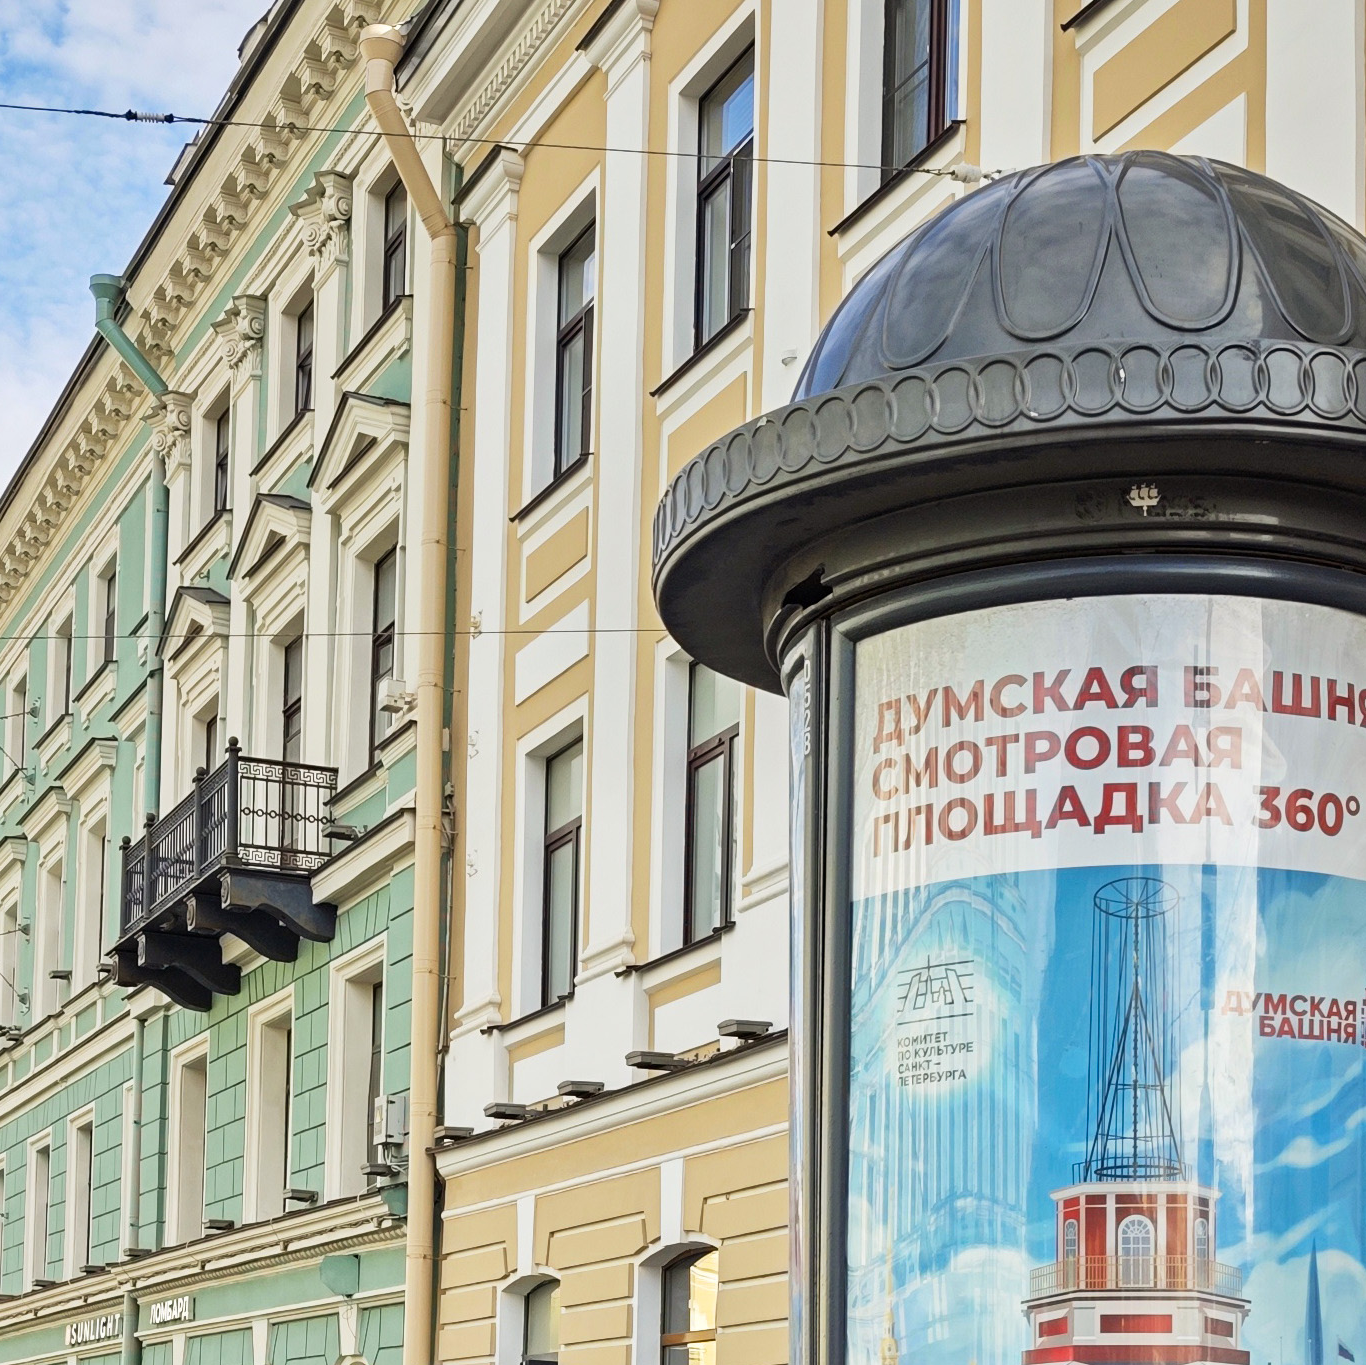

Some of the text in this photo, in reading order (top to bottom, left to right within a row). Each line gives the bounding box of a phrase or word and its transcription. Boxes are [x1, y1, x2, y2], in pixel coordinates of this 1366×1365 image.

[873, 665, 1158, 754] ДУМСКАЯ
[872, 724, 1243, 801] СМОТРОВАЯ
[873, 781, 1234, 858] ПЛОЩАДКА
[1221, 990, 1357, 1023] ДУМСКАЯ
[897, 1031, 948, 1049] КОМИТЕТ
[1259, 1015, 1357, 1045] БАШНЯ
[897, 1041, 974, 1062] ПО КУЛЬТУРЕ
[897, 1069, 967, 1087] ПЕТЕРБУРГА
[149, 1296, 190, 1325] ЛОМБАРД
[70, 1313, 121, 1345] SUNLIGHT
